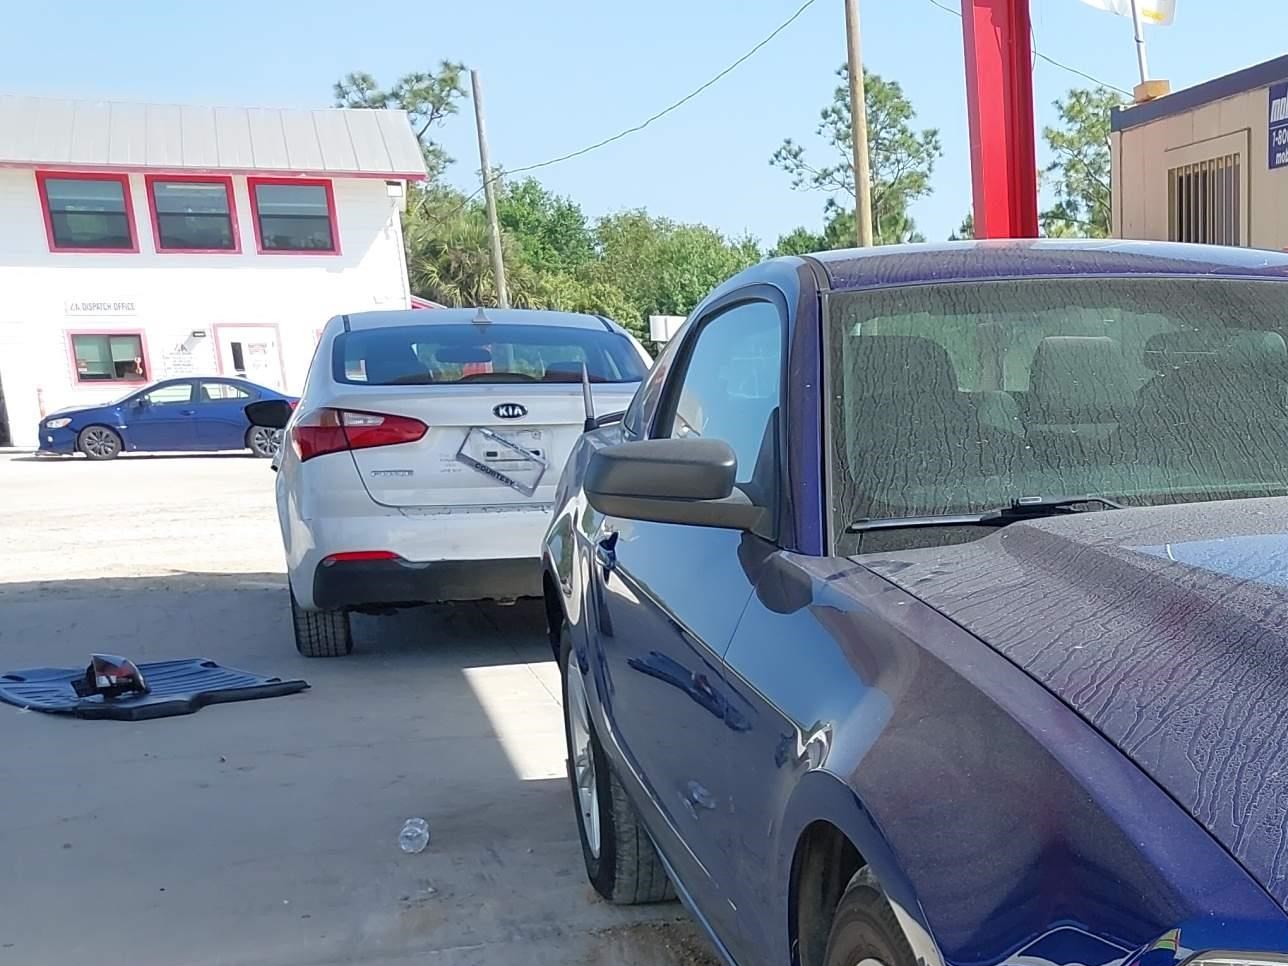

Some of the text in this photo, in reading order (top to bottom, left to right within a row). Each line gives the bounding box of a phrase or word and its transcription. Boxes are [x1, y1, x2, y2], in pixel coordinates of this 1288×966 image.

[81, 302, 112, 311] DISPATCH
[113, 302, 136, 311] OFFICE
[499, 406, 524, 417] KIA
[474, 462, 516, 487] COURTESY
